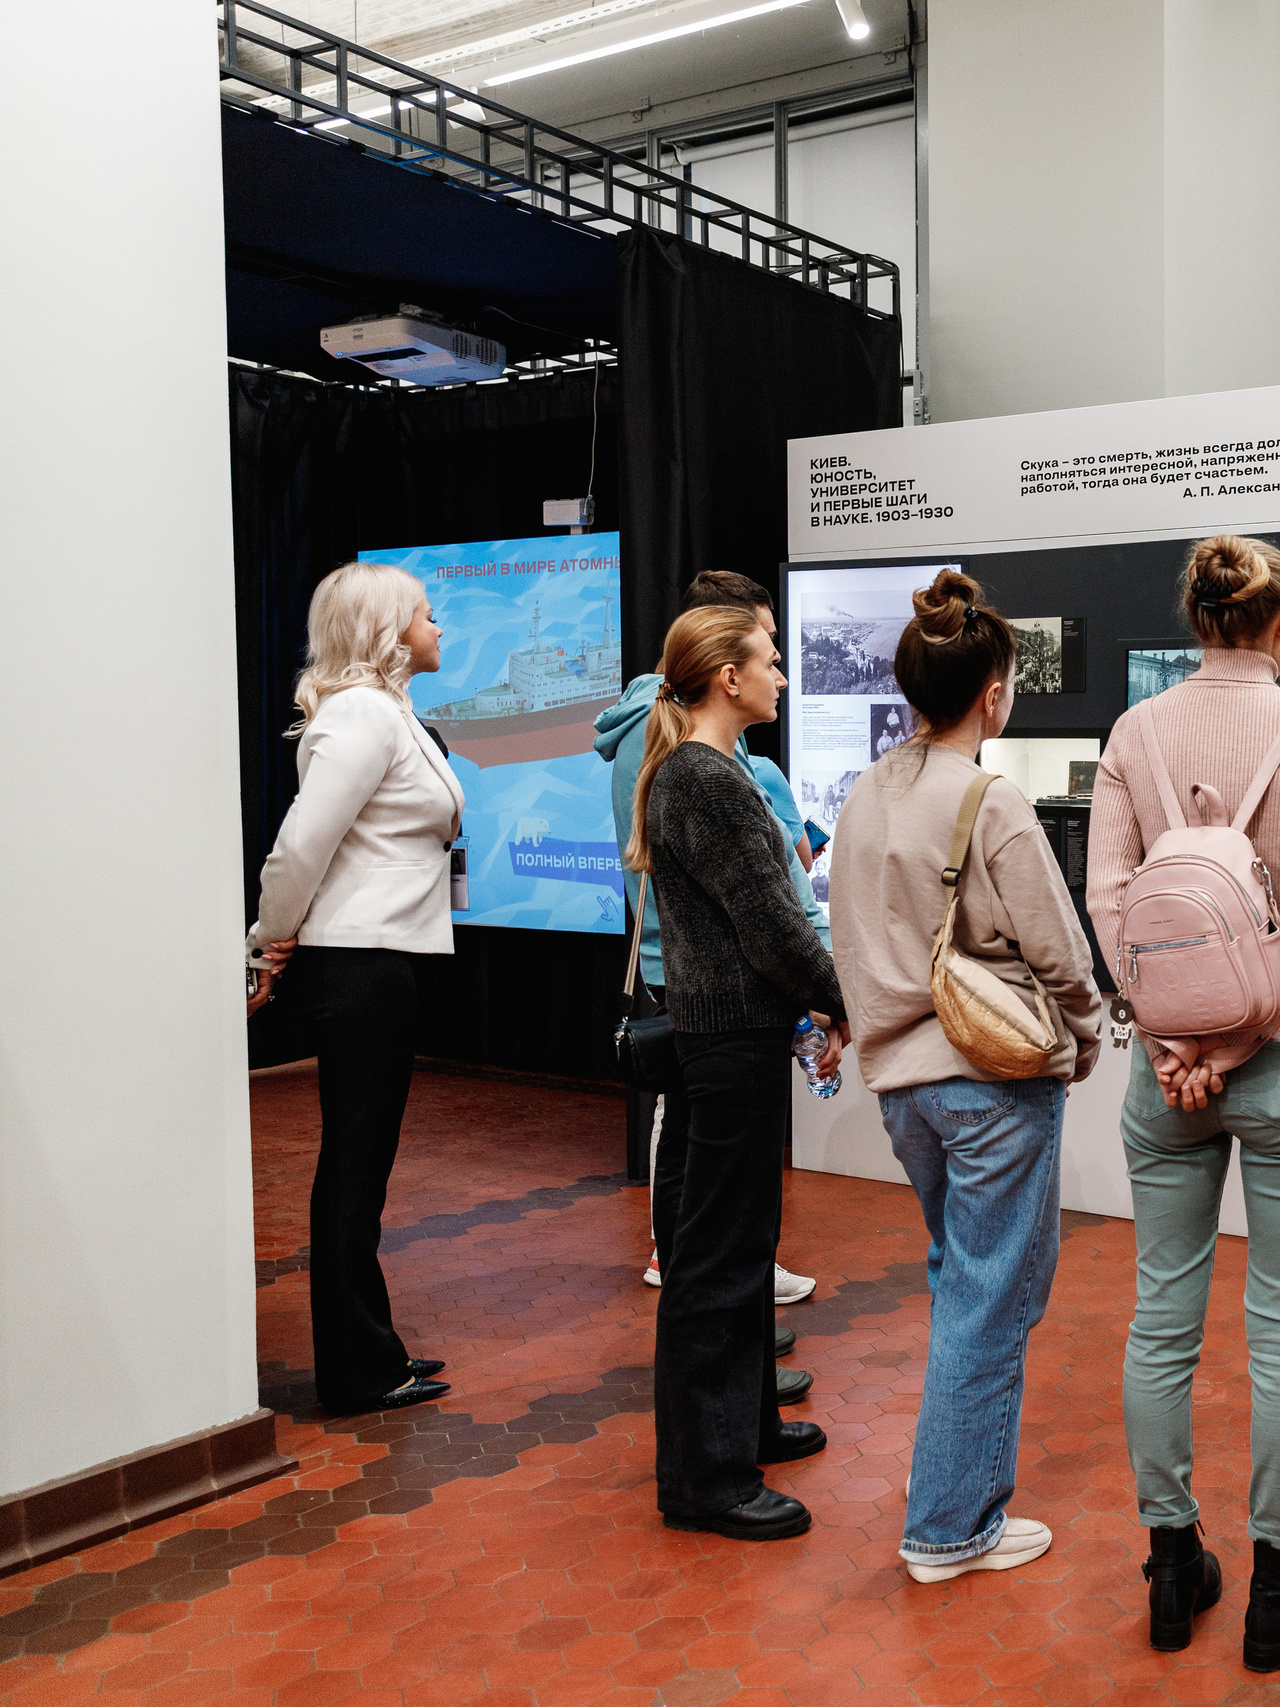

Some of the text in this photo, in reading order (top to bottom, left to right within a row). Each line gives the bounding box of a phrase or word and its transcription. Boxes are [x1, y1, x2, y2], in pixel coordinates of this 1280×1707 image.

[810, 455, 852, 470] КИЕВ.
[1020, 459, 1060, 472] Скука
[1072, 456, 1096, 466] это
[1098, 451, 1153, 464] смерть,
[1154, 446, 1200, 459] жизнь
[1202, 441, 1254, 454] всегда
[810, 468, 877, 485] ЮНОСТЬ,
[1020, 467, 1107, 483] наполняться
[1109, 456, 1198, 475] интересной,
[809, 478, 916, 499] УНИВЕРСИТЕТ
[1020, 466, 1269, 497] работой, тогда она будет счастьем.
[1182, 487, 1197, 499] А.
[1200, 485, 1215, 497] П.
[810, 492, 928, 514] И ПЕРВЫЕ ШАГИ
[810, 505, 954, 528] В НАУКЕ. 1903–1930
[437, 560, 496, 579] ПЕРВЫЙ
[500, 563, 510, 576] В
[514, 560, 556, 575] МИРЕ
[516, 852, 575, 869] ПОЛНЫЙ
